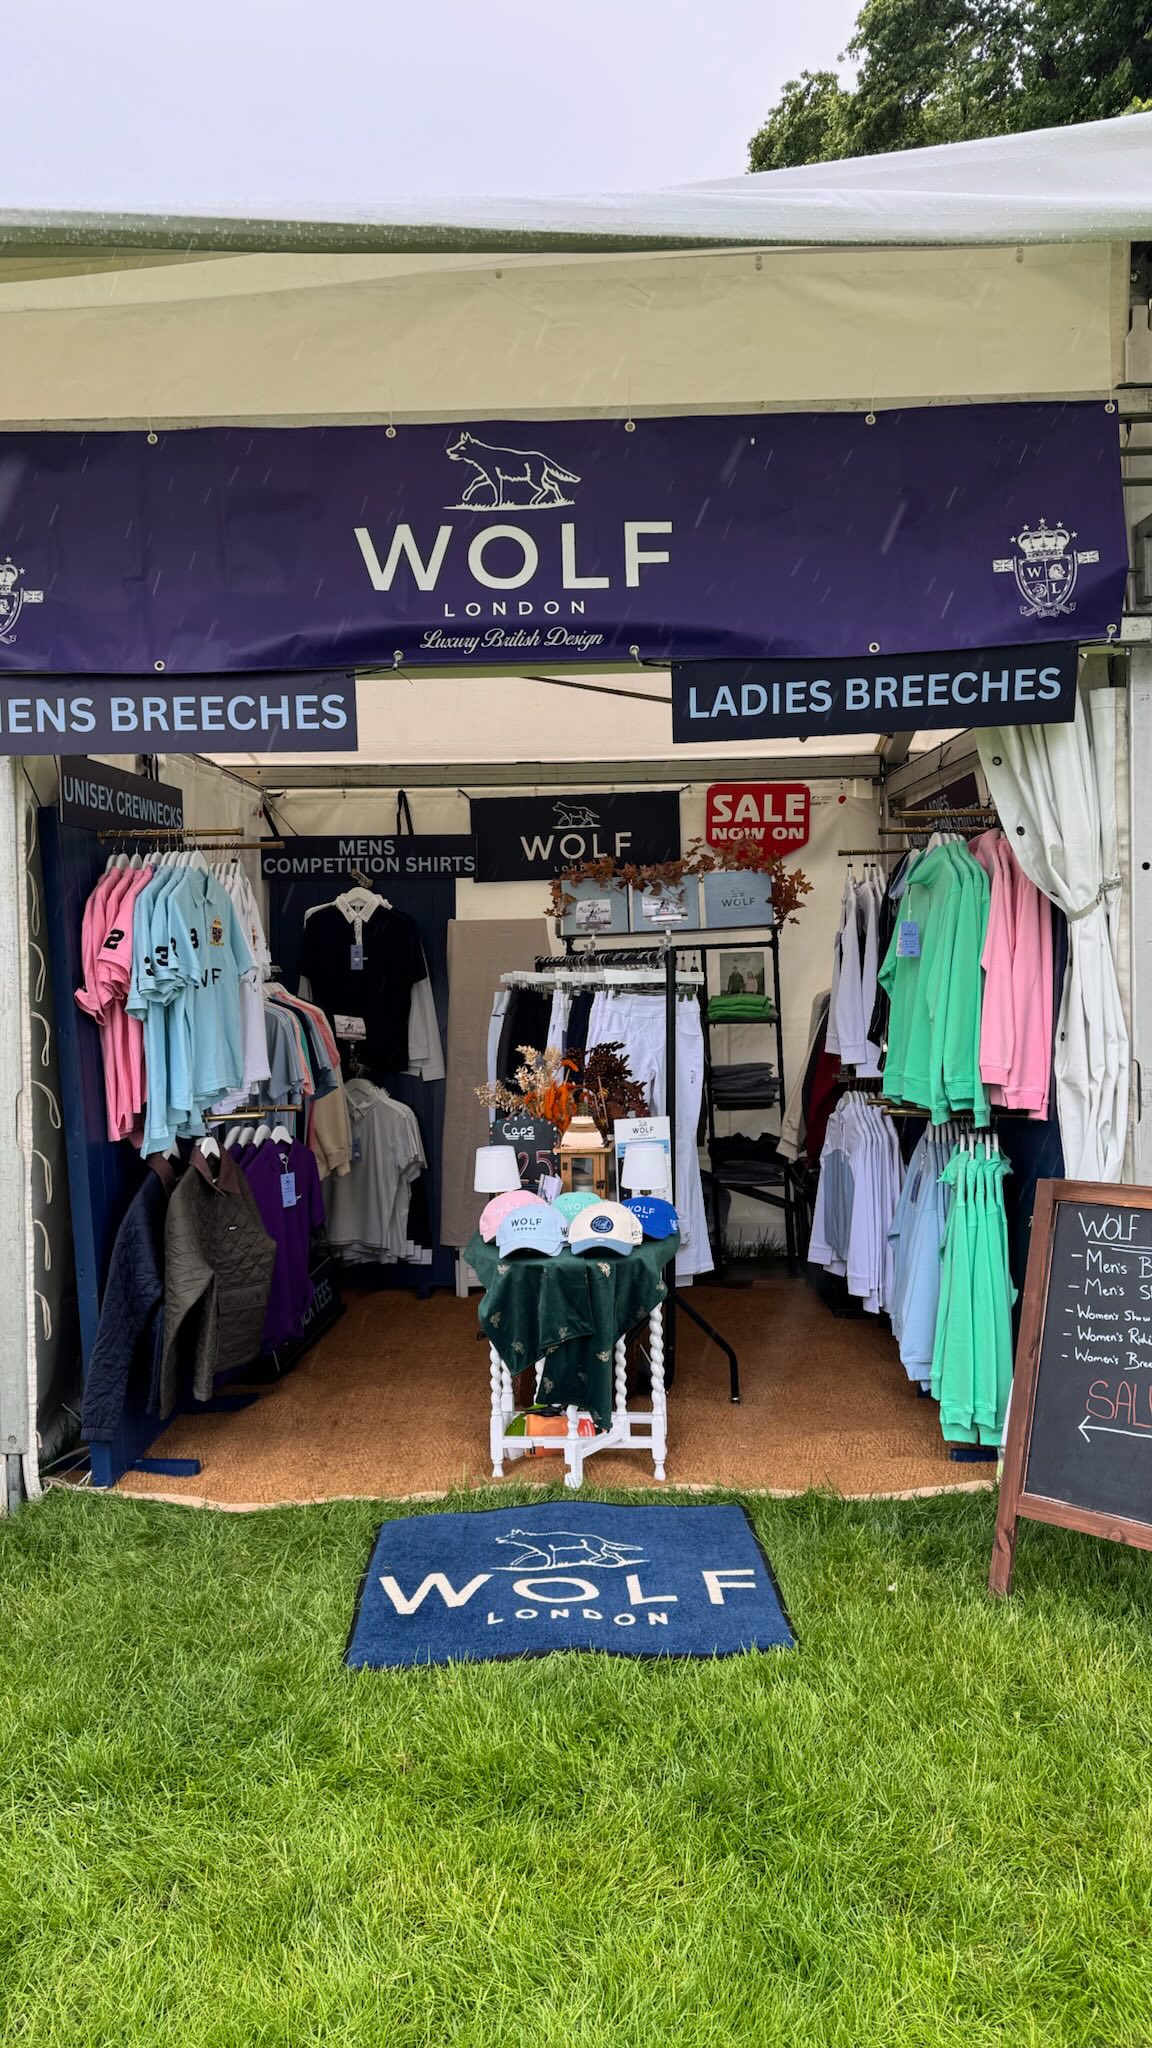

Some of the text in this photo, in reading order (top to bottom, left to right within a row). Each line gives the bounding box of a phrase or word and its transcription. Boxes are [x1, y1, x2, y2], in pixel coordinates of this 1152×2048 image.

[354, 521, 673, 591] WOLF
[444, 600, 585, 617] LONDON
[419, 626, 604, 655] Luxury British Design
[688, 666, 1062, 719] LADIES BREECHES
[0, 694, 348, 733] ENS BREECHES
[63, 775, 183, 829] UNISEX CREWNECKS
[711, 793, 806, 823] SALE
[711, 827, 805, 841] NOW ON
[338, 839, 396, 856] MENS
[520, 831, 632, 861] WOLF
[263, 855, 476, 874] COMPETITION SHIRTS
[721, 897, 756, 908] WOLF
[103, 928, 125, 950] 2
[502, 1122, 535, 1137] Caps
[632, 1126, 654, 1134] WOLF
[510, 1217, 543, 1227] WOLF
[1077, 1211, 1141, 1242] WOLF
[1086, 1248, 1128, 1275] Men's
[1084, 1277, 1125, 1297] Men's
[1077, 1303, 1151, 1322] Women's Show
[1077, 1324, 1123, 1343] Women's
[1074, 1346, 1119, 1365] Women's
[379, 1568, 757, 1615] WOLF
[487, 1607, 669, 1626] LONDON
